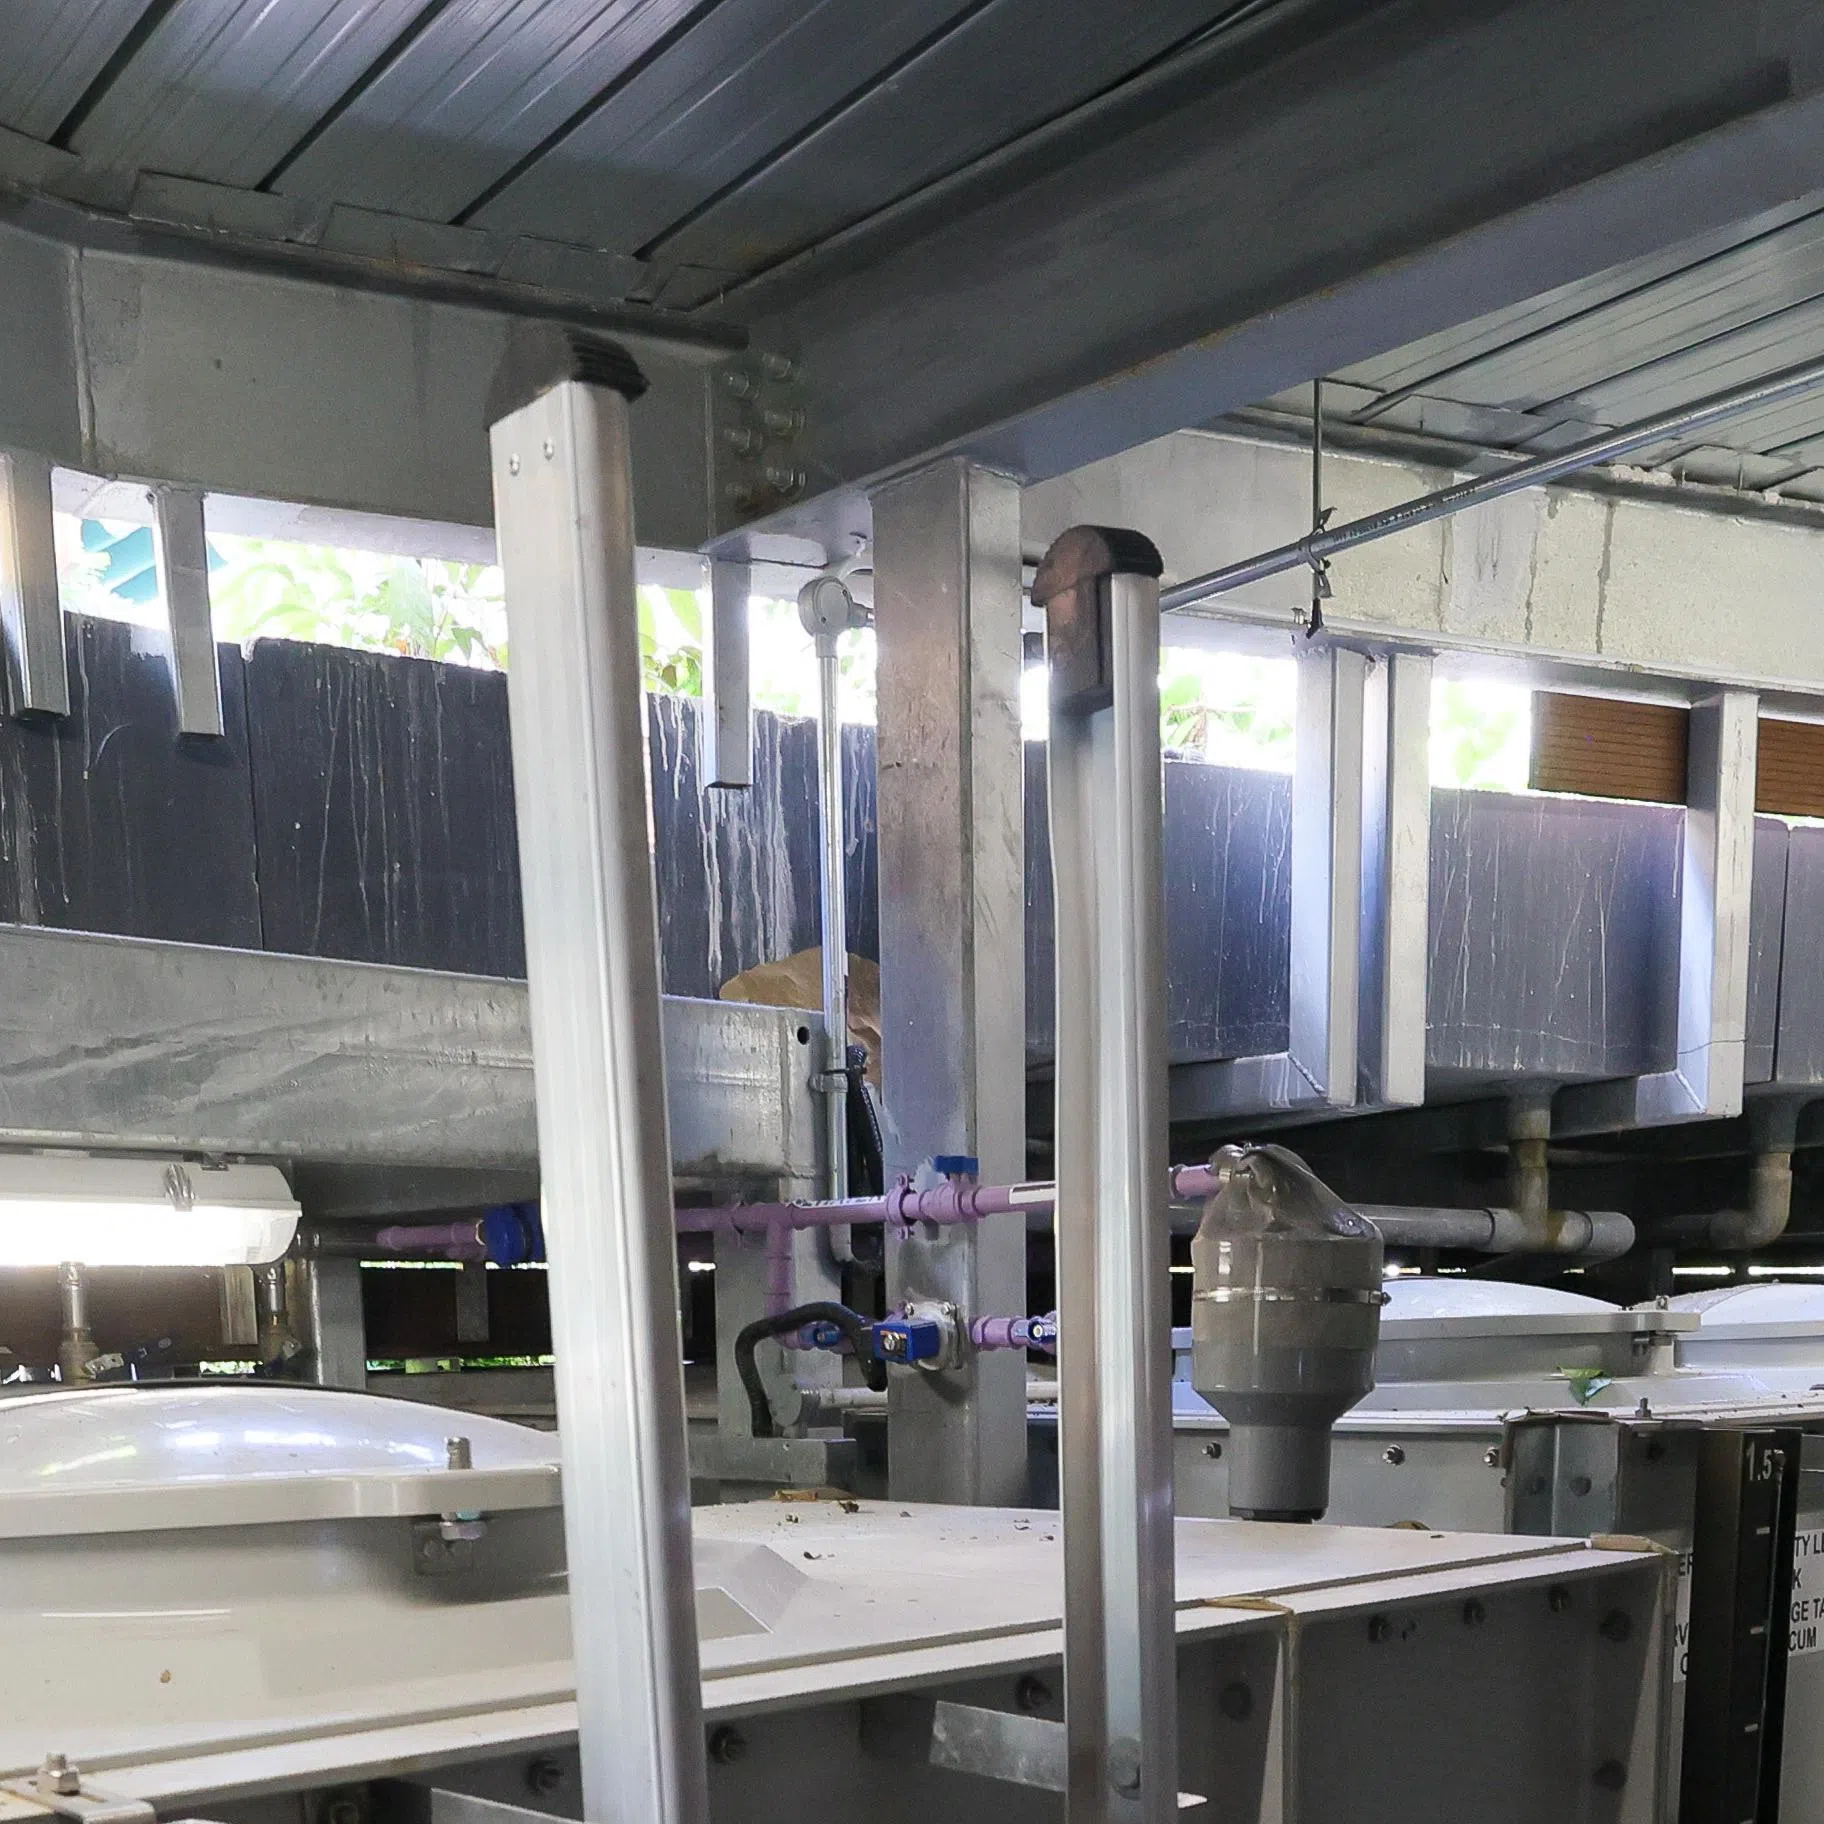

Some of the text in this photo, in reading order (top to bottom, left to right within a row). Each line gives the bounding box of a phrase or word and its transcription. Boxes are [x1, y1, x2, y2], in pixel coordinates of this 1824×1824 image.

[1746, 1441, 1773, 1482] 1.5
[1793, 1535, 1811, 1558] TY
[1790, 1599, 1809, 1624] GE
[1788, 1626, 1817, 1652] CUM
